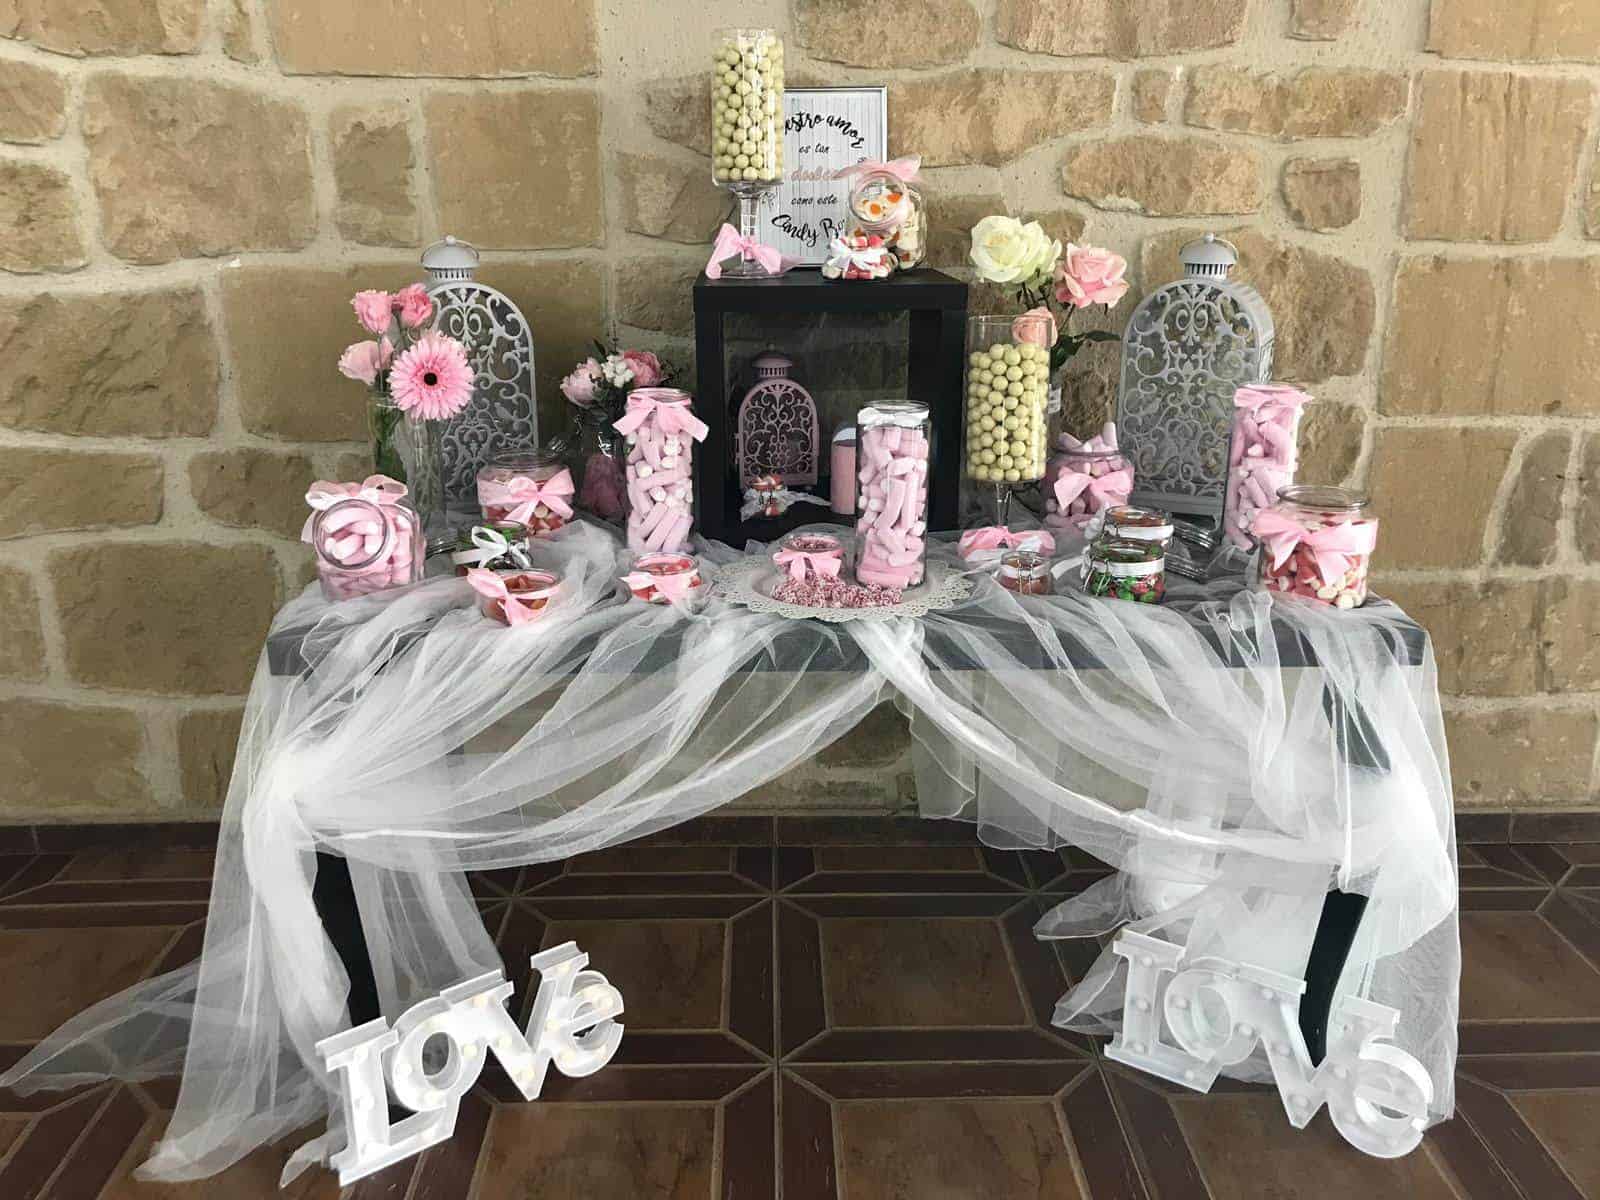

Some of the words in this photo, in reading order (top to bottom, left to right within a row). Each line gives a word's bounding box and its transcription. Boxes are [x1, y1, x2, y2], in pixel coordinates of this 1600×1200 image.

[784, 111, 825, 136] estro
[826, 113, 865, 149] amor
[798, 145, 812, 154] es
[790, 196, 813, 206] como
[816, 193, 838, 206] este
[771, 213, 819, 248] Candy
